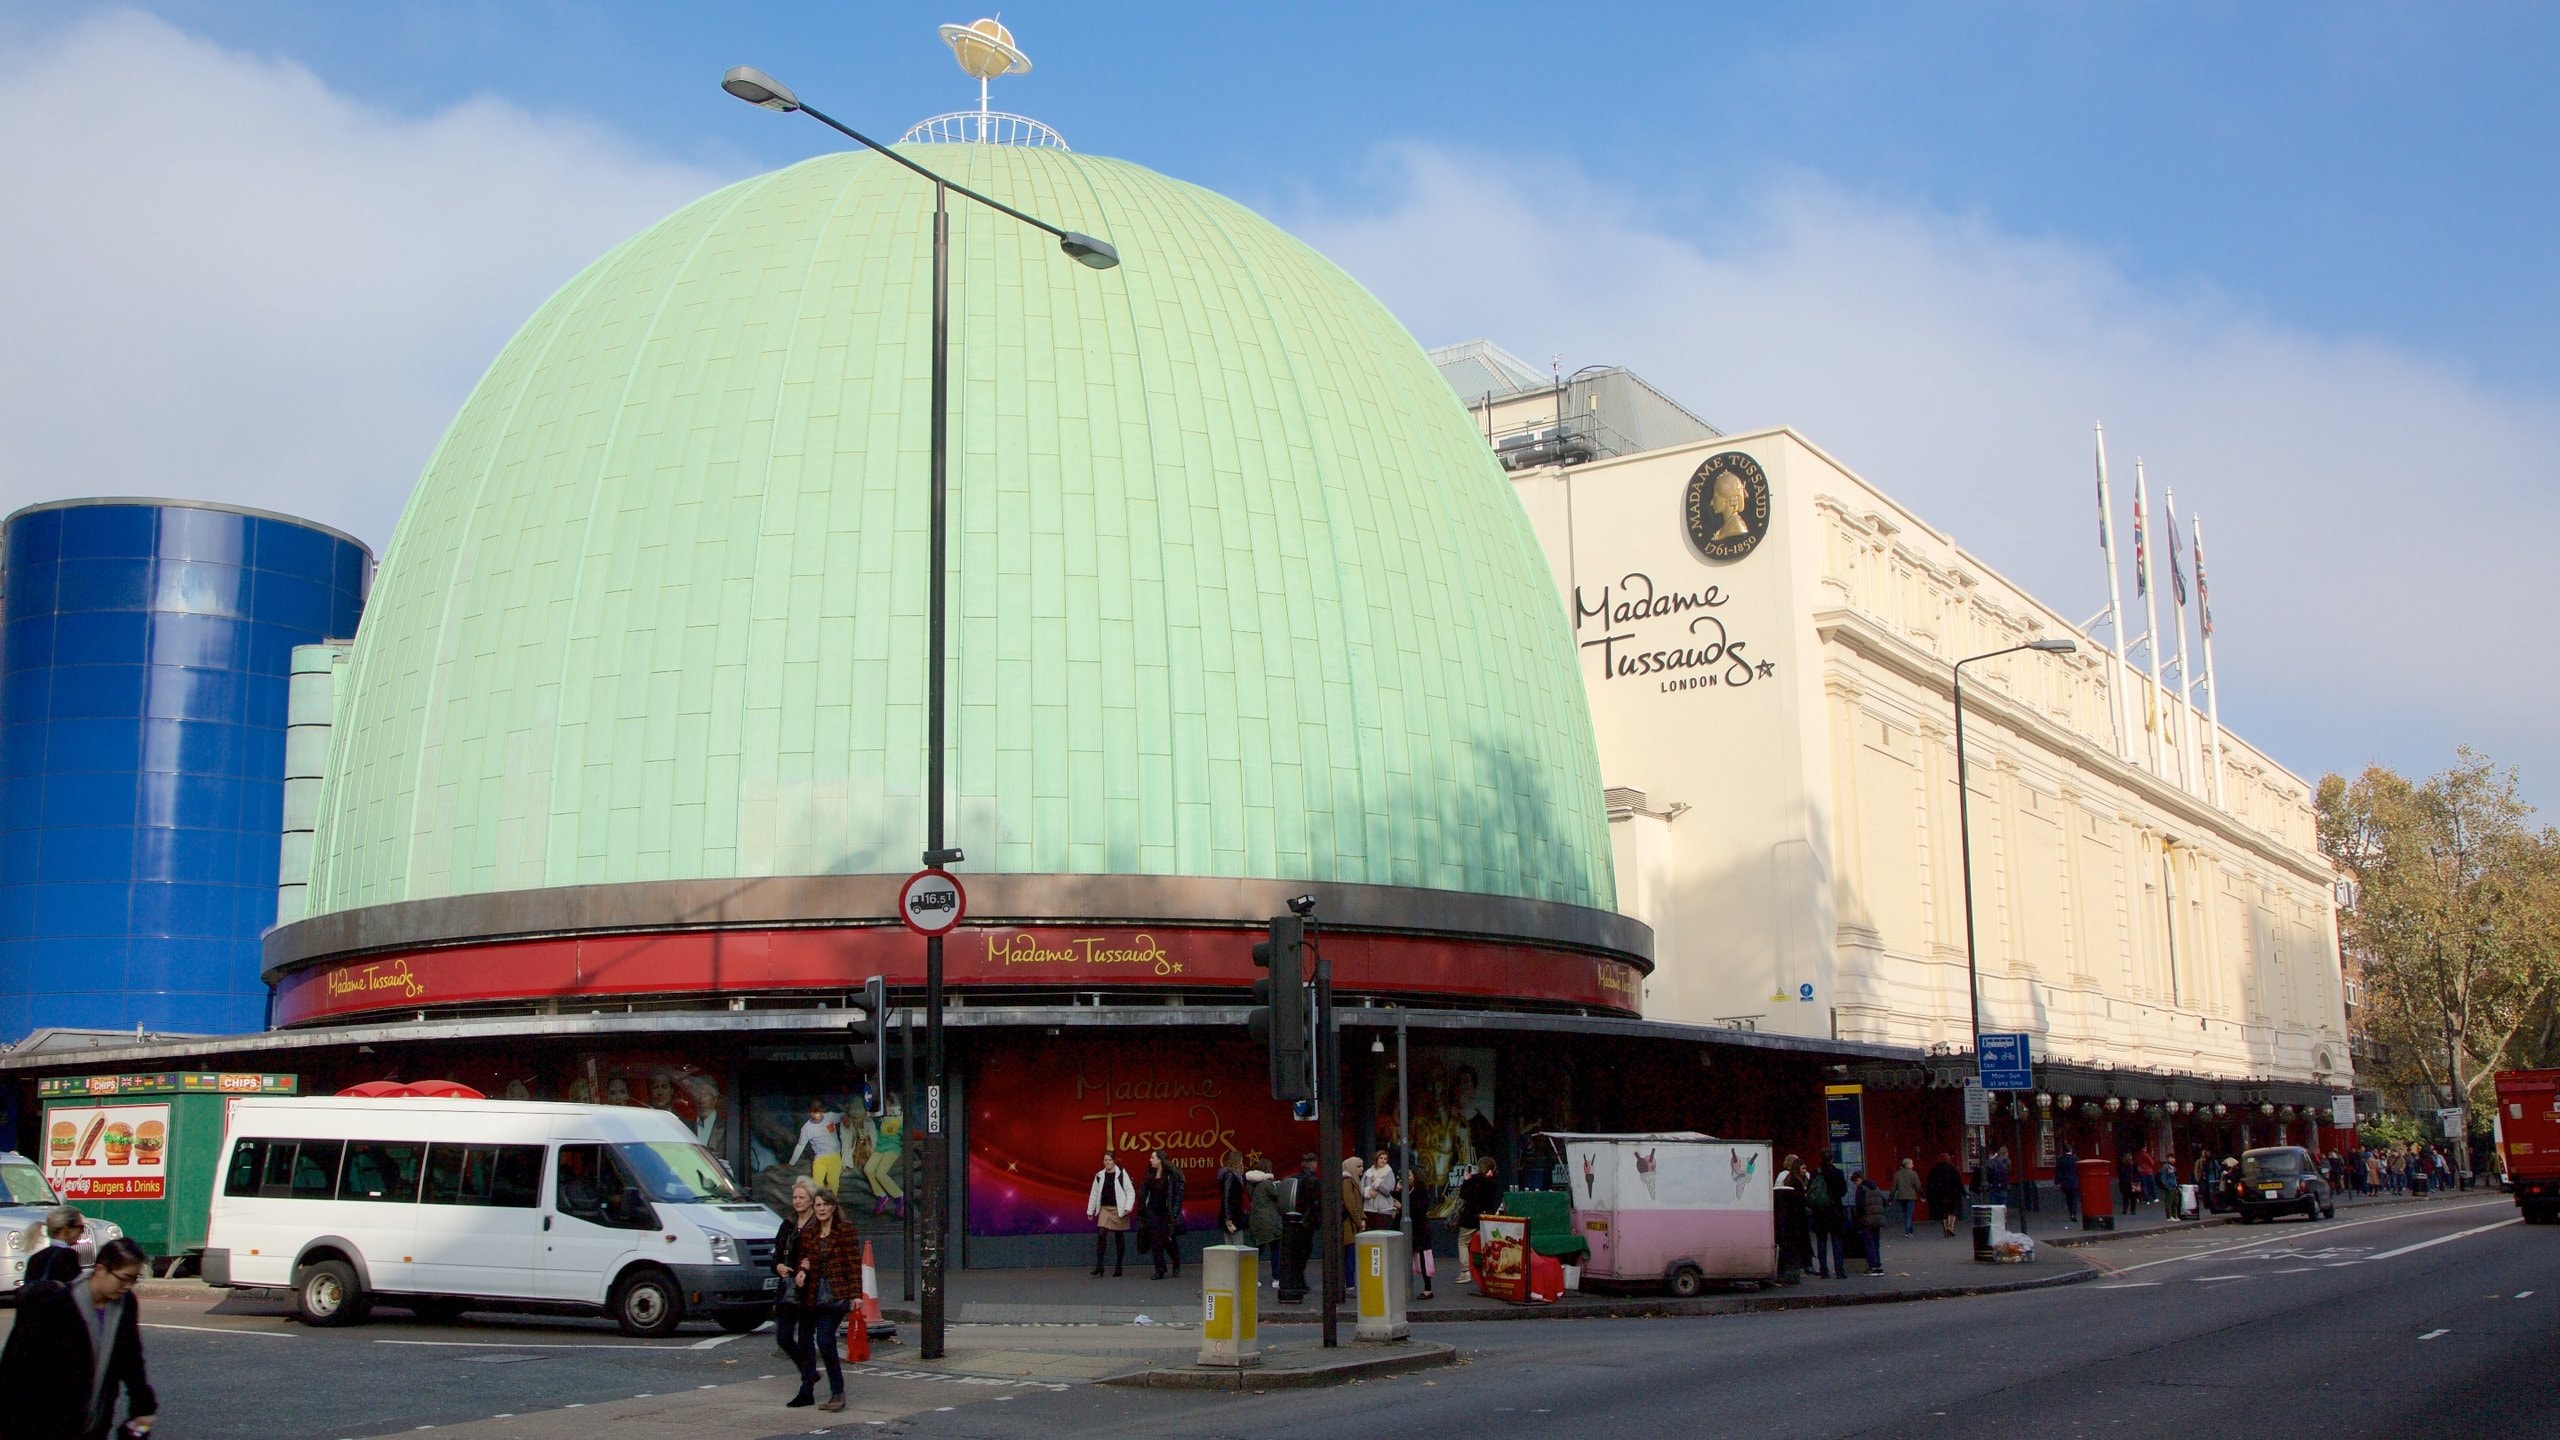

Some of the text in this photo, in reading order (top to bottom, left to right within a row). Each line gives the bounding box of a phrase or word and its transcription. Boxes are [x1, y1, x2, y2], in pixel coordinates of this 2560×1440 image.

[1690, 455, 1766, 530] MADAME TUSSAUD
[1704, 536, 1757, 556] 1761-1850
[1575, 573, 1730, 632] Madame
[1581, 616, 1754, 687] Tussauds
[1661, 675, 1718, 694] LONDON
[988, 934, 1171, 976] Madame Tussauds
[329, 959, 416, 998] Madame Tussauds
[94, 1081, 116, 1090] CHIPS
[224, 1079, 257, 1087] CHIPS
[1077, 1060, 1222, 1106] Madame
[930, 1088, 938, 1131] 0046
[1082, 1104, 1243, 1168] Tussauds
[1171, 1157, 1214, 1168] ONDON
[93, 1180, 124, 1195] Burgers
[126, 1180, 132, 1192] &
[134, 1180, 160, 1193] Drinks
